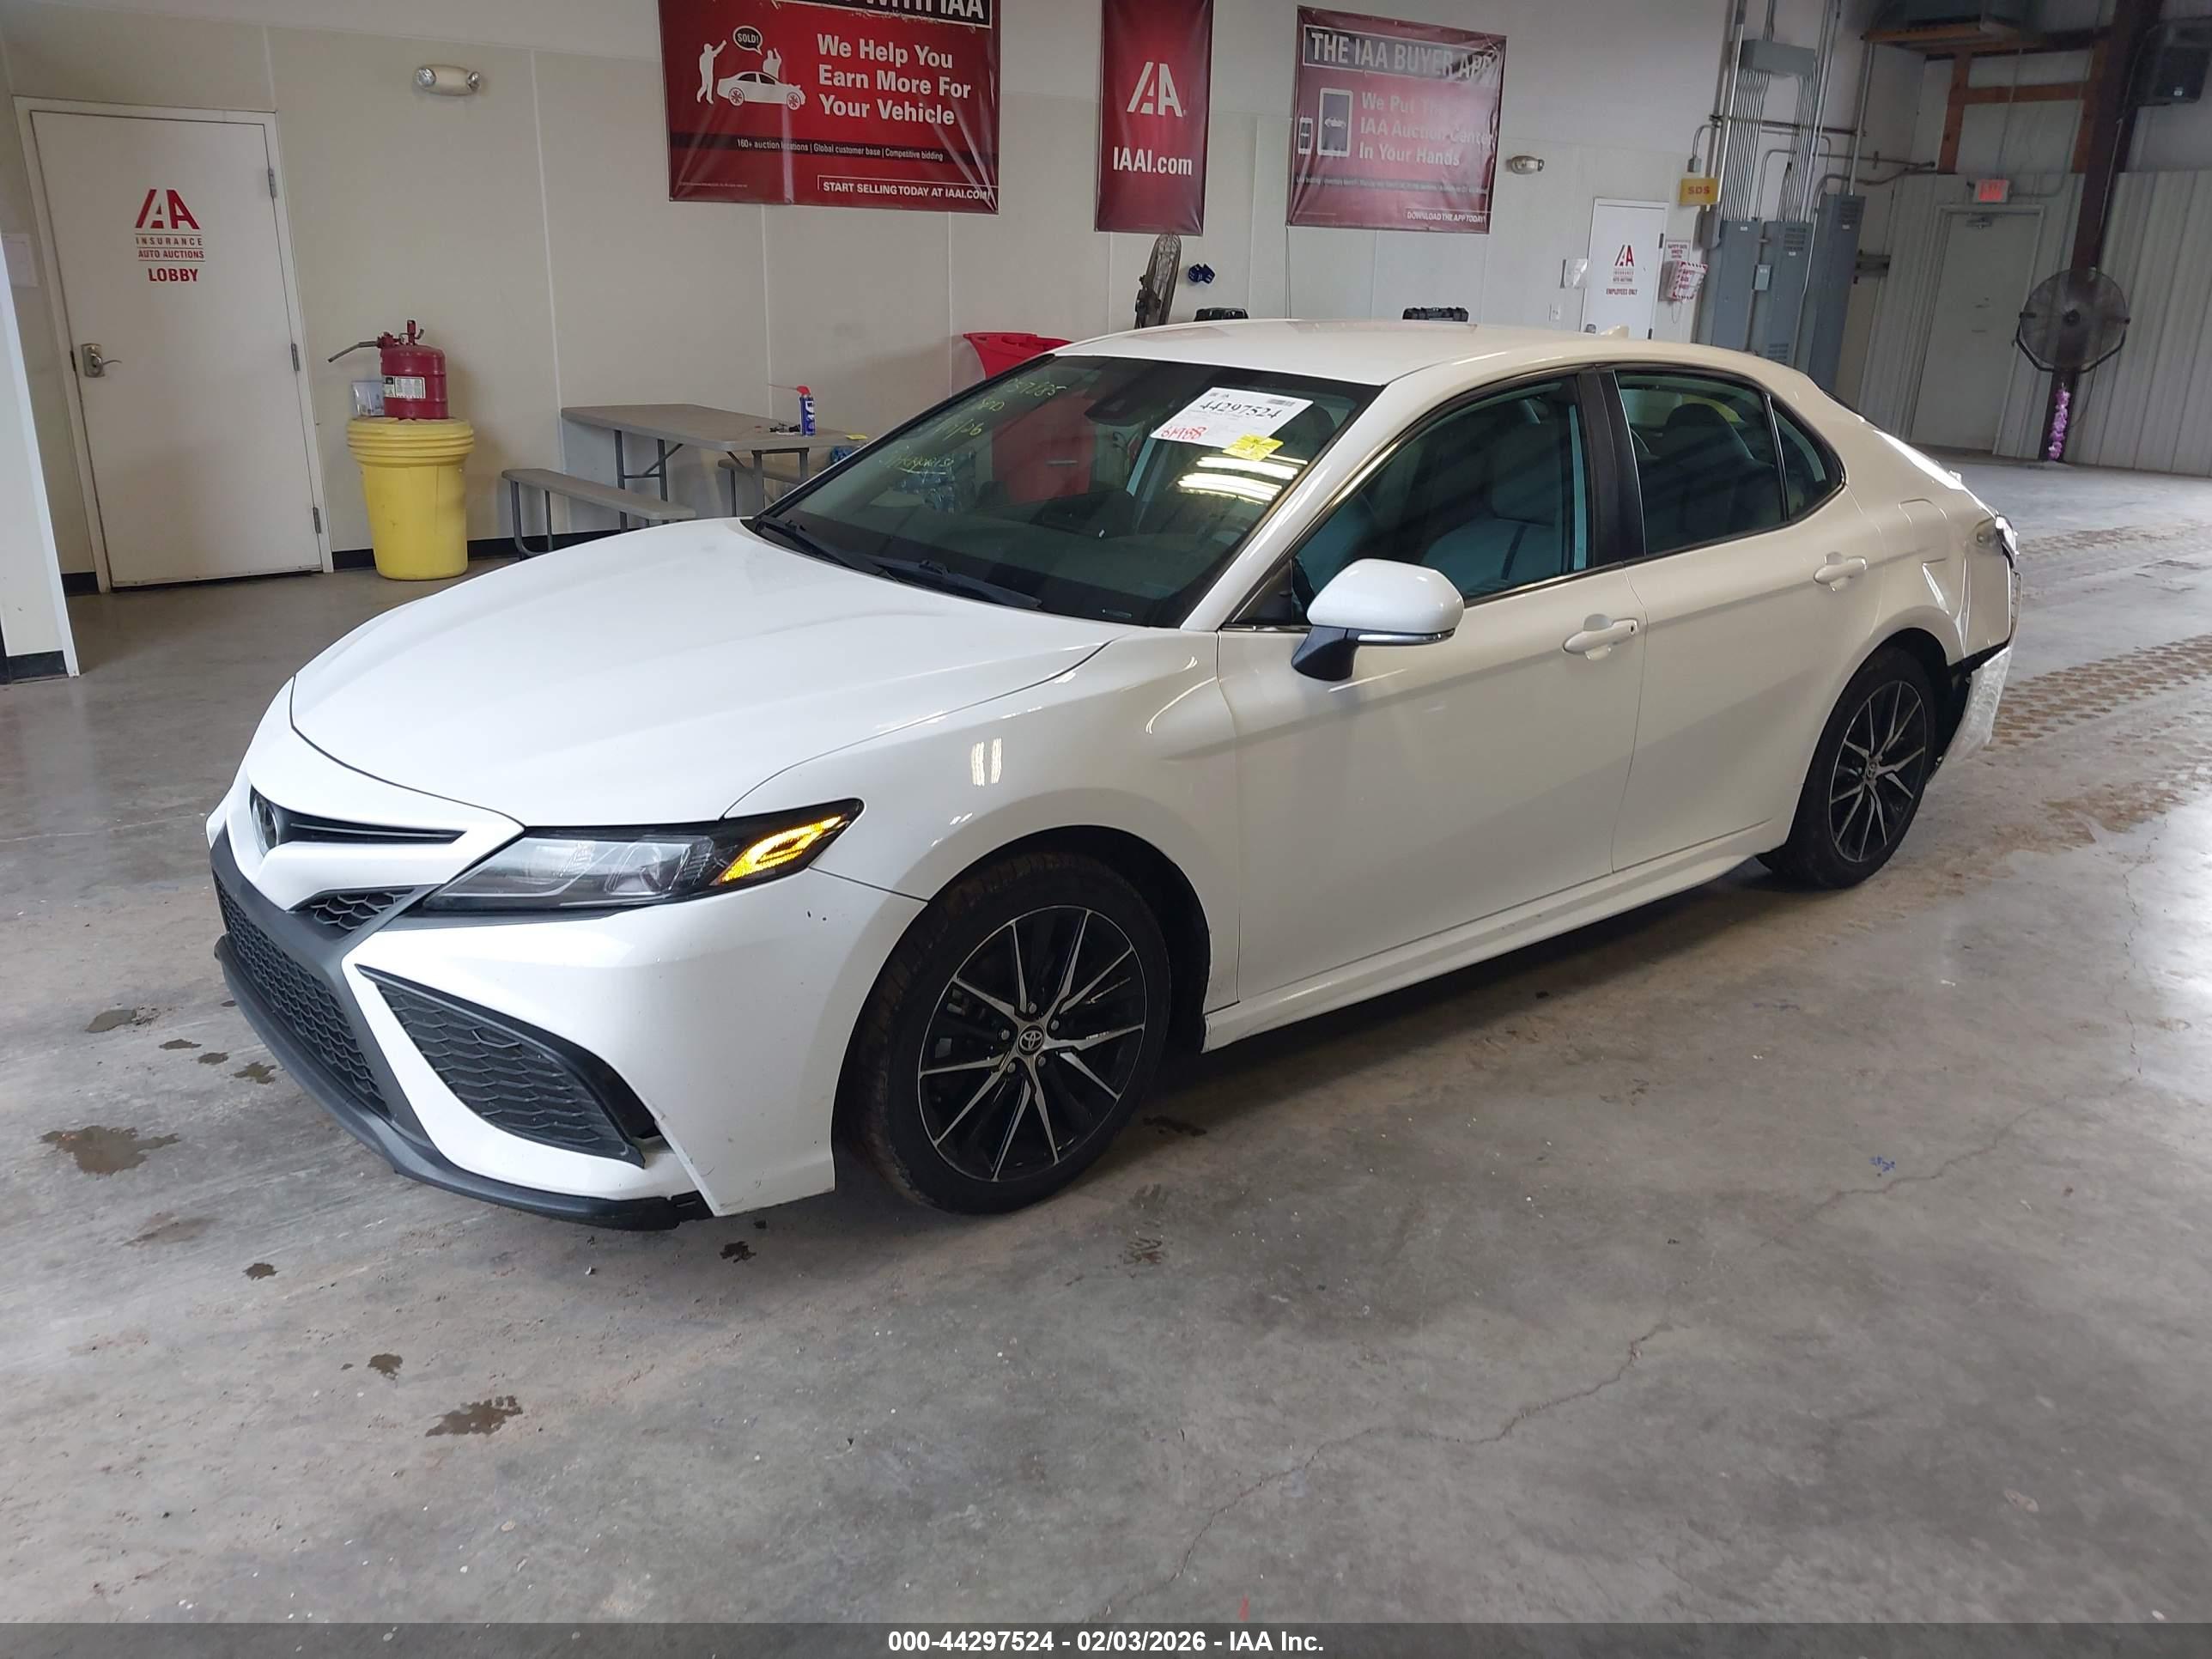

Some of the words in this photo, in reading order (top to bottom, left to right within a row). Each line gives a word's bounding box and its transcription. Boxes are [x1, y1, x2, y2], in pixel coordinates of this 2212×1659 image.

[737, 33, 759, 44] SOLD!
[817, 33, 852, 58] We
[859, 38, 908, 68] Help
[914, 44, 953, 69] You
[1311, 31, 1350, 64] THE
[1354, 38, 1389, 69] IAA
[1394, 44, 1454, 76] BUYER
[818, 64, 869, 88] Earn
[877, 70, 932, 94] More
[939, 76, 971, 99] For
[818, 94, 870, 118] Your
[877, 98, 955, 125] Vehicle
[1361, 92, 1384, 111] We
[1390, 95, 1415, 113] Put
[1360, 116, 1389, 136] IAA
[1391, 120, 1447, 141] Auction
[738, 138, 752, 148] 160+
[754, 140, 780, 149] auction
[813, 143, 834, 153] Global
[835, 143, 864, 155] customer
[865, 147, 880, 156] base
[921, 150, 943, 161] bidding
[1359, 141, 1374, 159] In
[1379, 143, 1411, 162] Your
[1416, 147, 1460, 166] Hands
[1113, 146, 1193, 176] IAAI.com
[823, 181, 854, 193] START
[857, 183, 897, 195] SELLING
[898, 185, 930, 197] TODAY
[931, 187, 944, 197] AT
[1688, 185, 1710, 194] SDS
[1407, 211, 1441, 221] DOWNLOAD
[136, 237, 203, 246] INSURANCE
[138, 250, 161, 258] AUTO
[163, 250, 204, 258] AUCTIONS
[148, 268, 198, 282] LOBBY
[1200, 400, 1284, 419] 44297524
